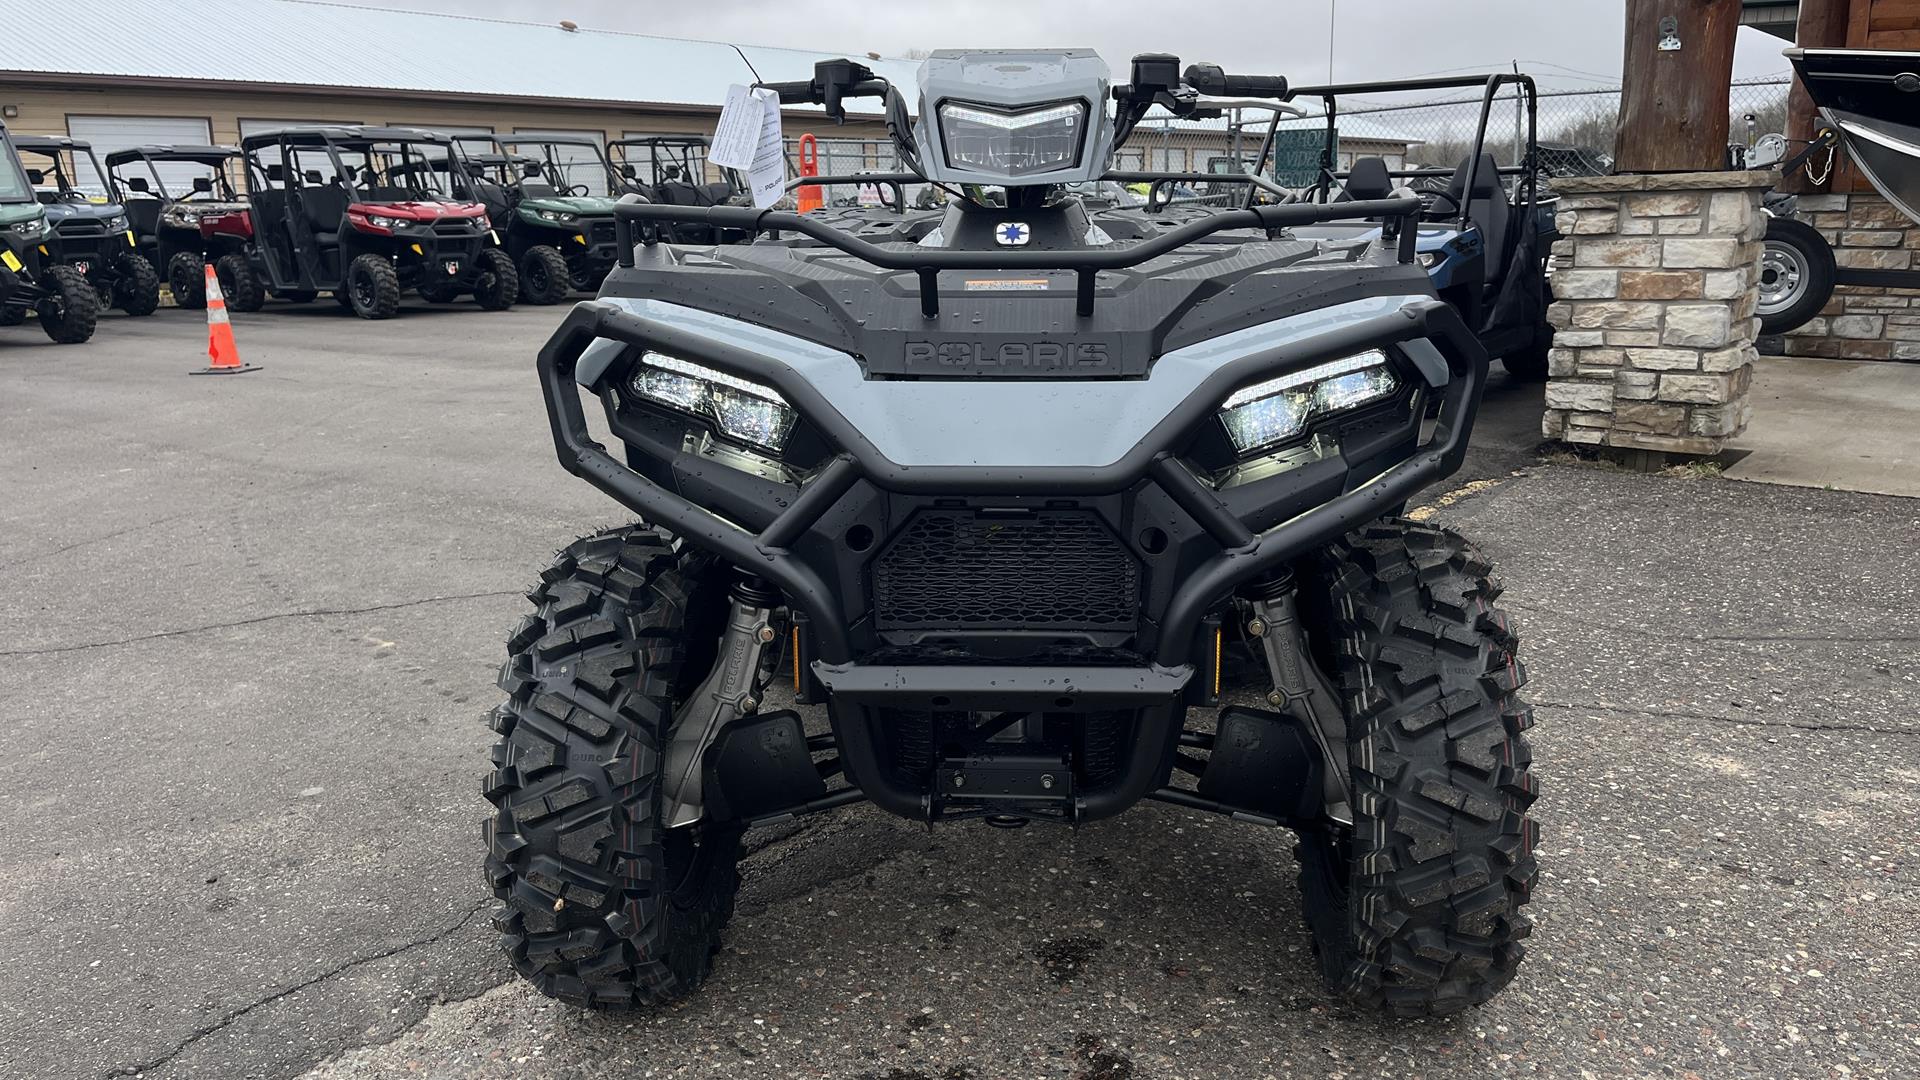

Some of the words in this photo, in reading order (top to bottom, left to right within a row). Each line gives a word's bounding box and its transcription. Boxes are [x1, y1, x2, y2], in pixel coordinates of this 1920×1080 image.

[1277, 170, 1322, 187] SECUR
[905, 341, 1109, 367] POLARIS
[724, 639, 746, 694] POLARIS
[1278, 631, 1300, 688] POLARIS
[572, 753, 603, 762] DURO
